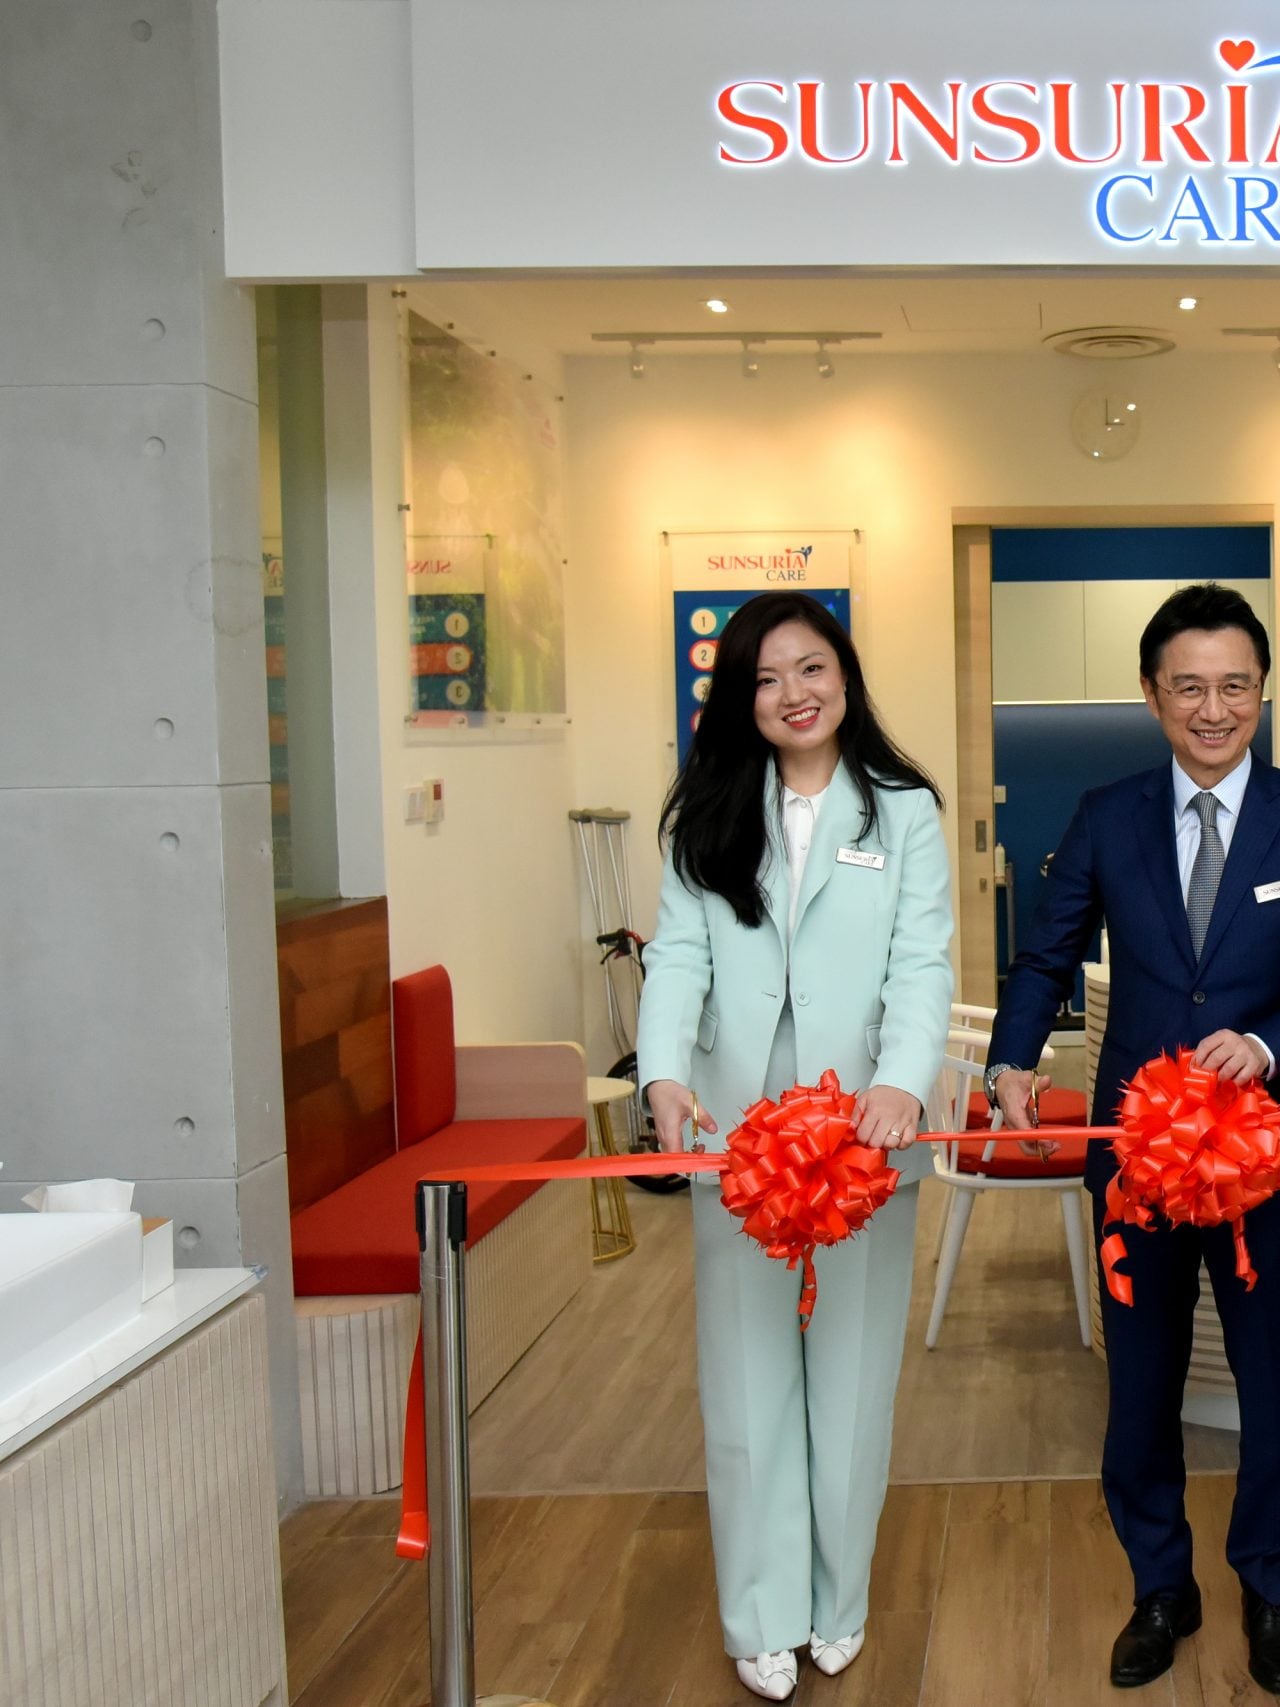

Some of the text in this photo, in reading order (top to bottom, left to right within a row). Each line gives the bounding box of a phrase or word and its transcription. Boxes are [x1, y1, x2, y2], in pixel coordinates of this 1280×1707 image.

[708, 555, 804, 570] SUNSURIA
[766, 569, 806, 581] CARE
[701, 649, 708, 661] 2
